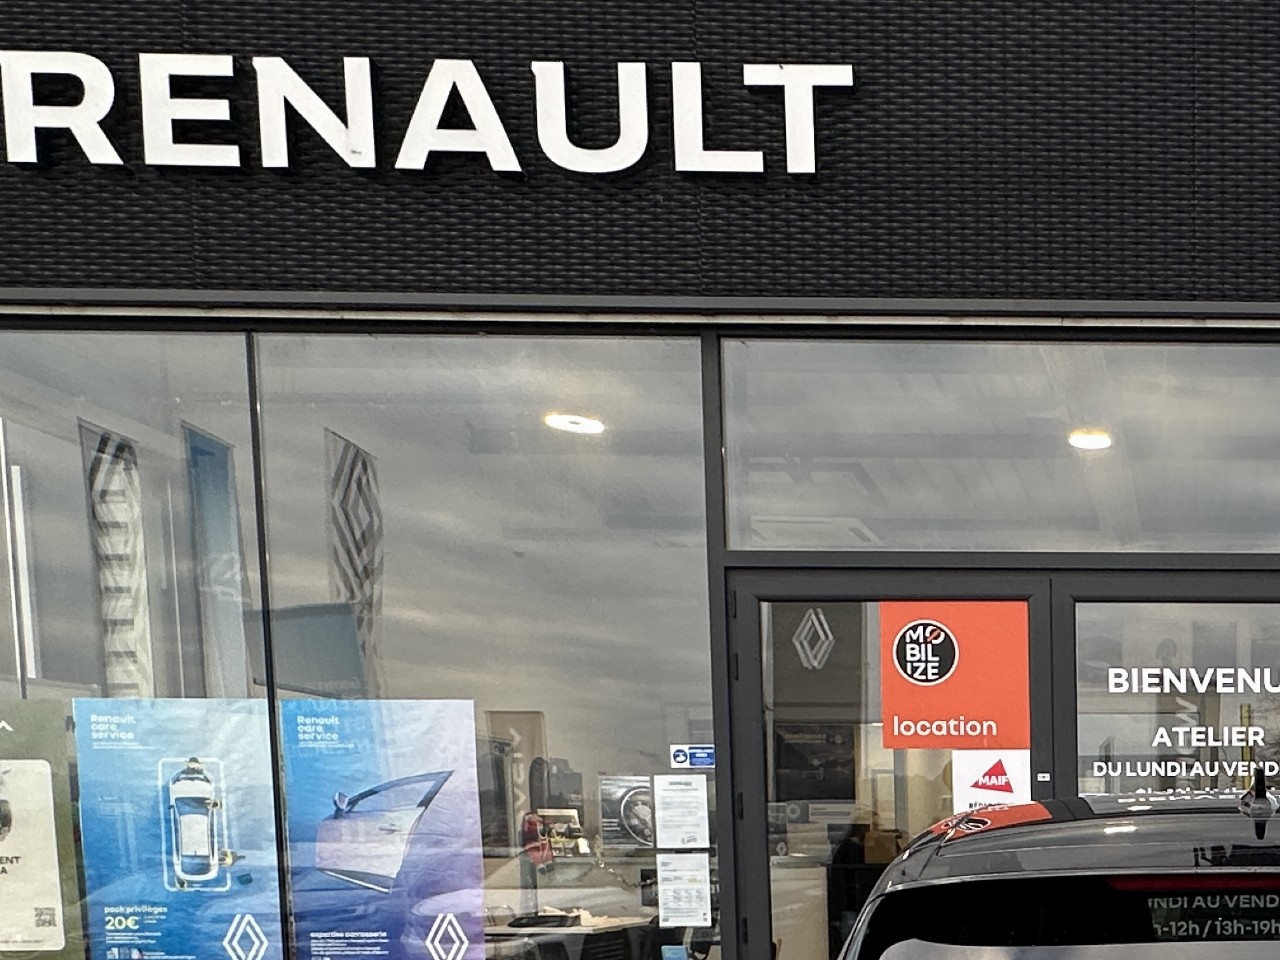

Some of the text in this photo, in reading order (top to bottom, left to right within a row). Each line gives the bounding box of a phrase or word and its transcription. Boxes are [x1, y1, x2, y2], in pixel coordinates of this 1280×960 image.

[0, 50, 854, 174] RENAULT
[90, 714, 136, 724] Renault
[297, 715, 340, 725] Renault
[90, 723, 118, 731] care
[893, 715, 998, 736] location
[91, 730, 135, 740] service
[298, 733, 339, 741] service
[1152, 726, 1265, 748] ATELIER
[1093, 761, 1122, 777] DU
[1125, 762, 1187, 777] LUNDI
[1191, 761, 1219, 777] AU
[978, 776, 1010, 786] MAIF
[1192, 895, 1220, 908] AU
[105, 916, 140, 930] 20€
